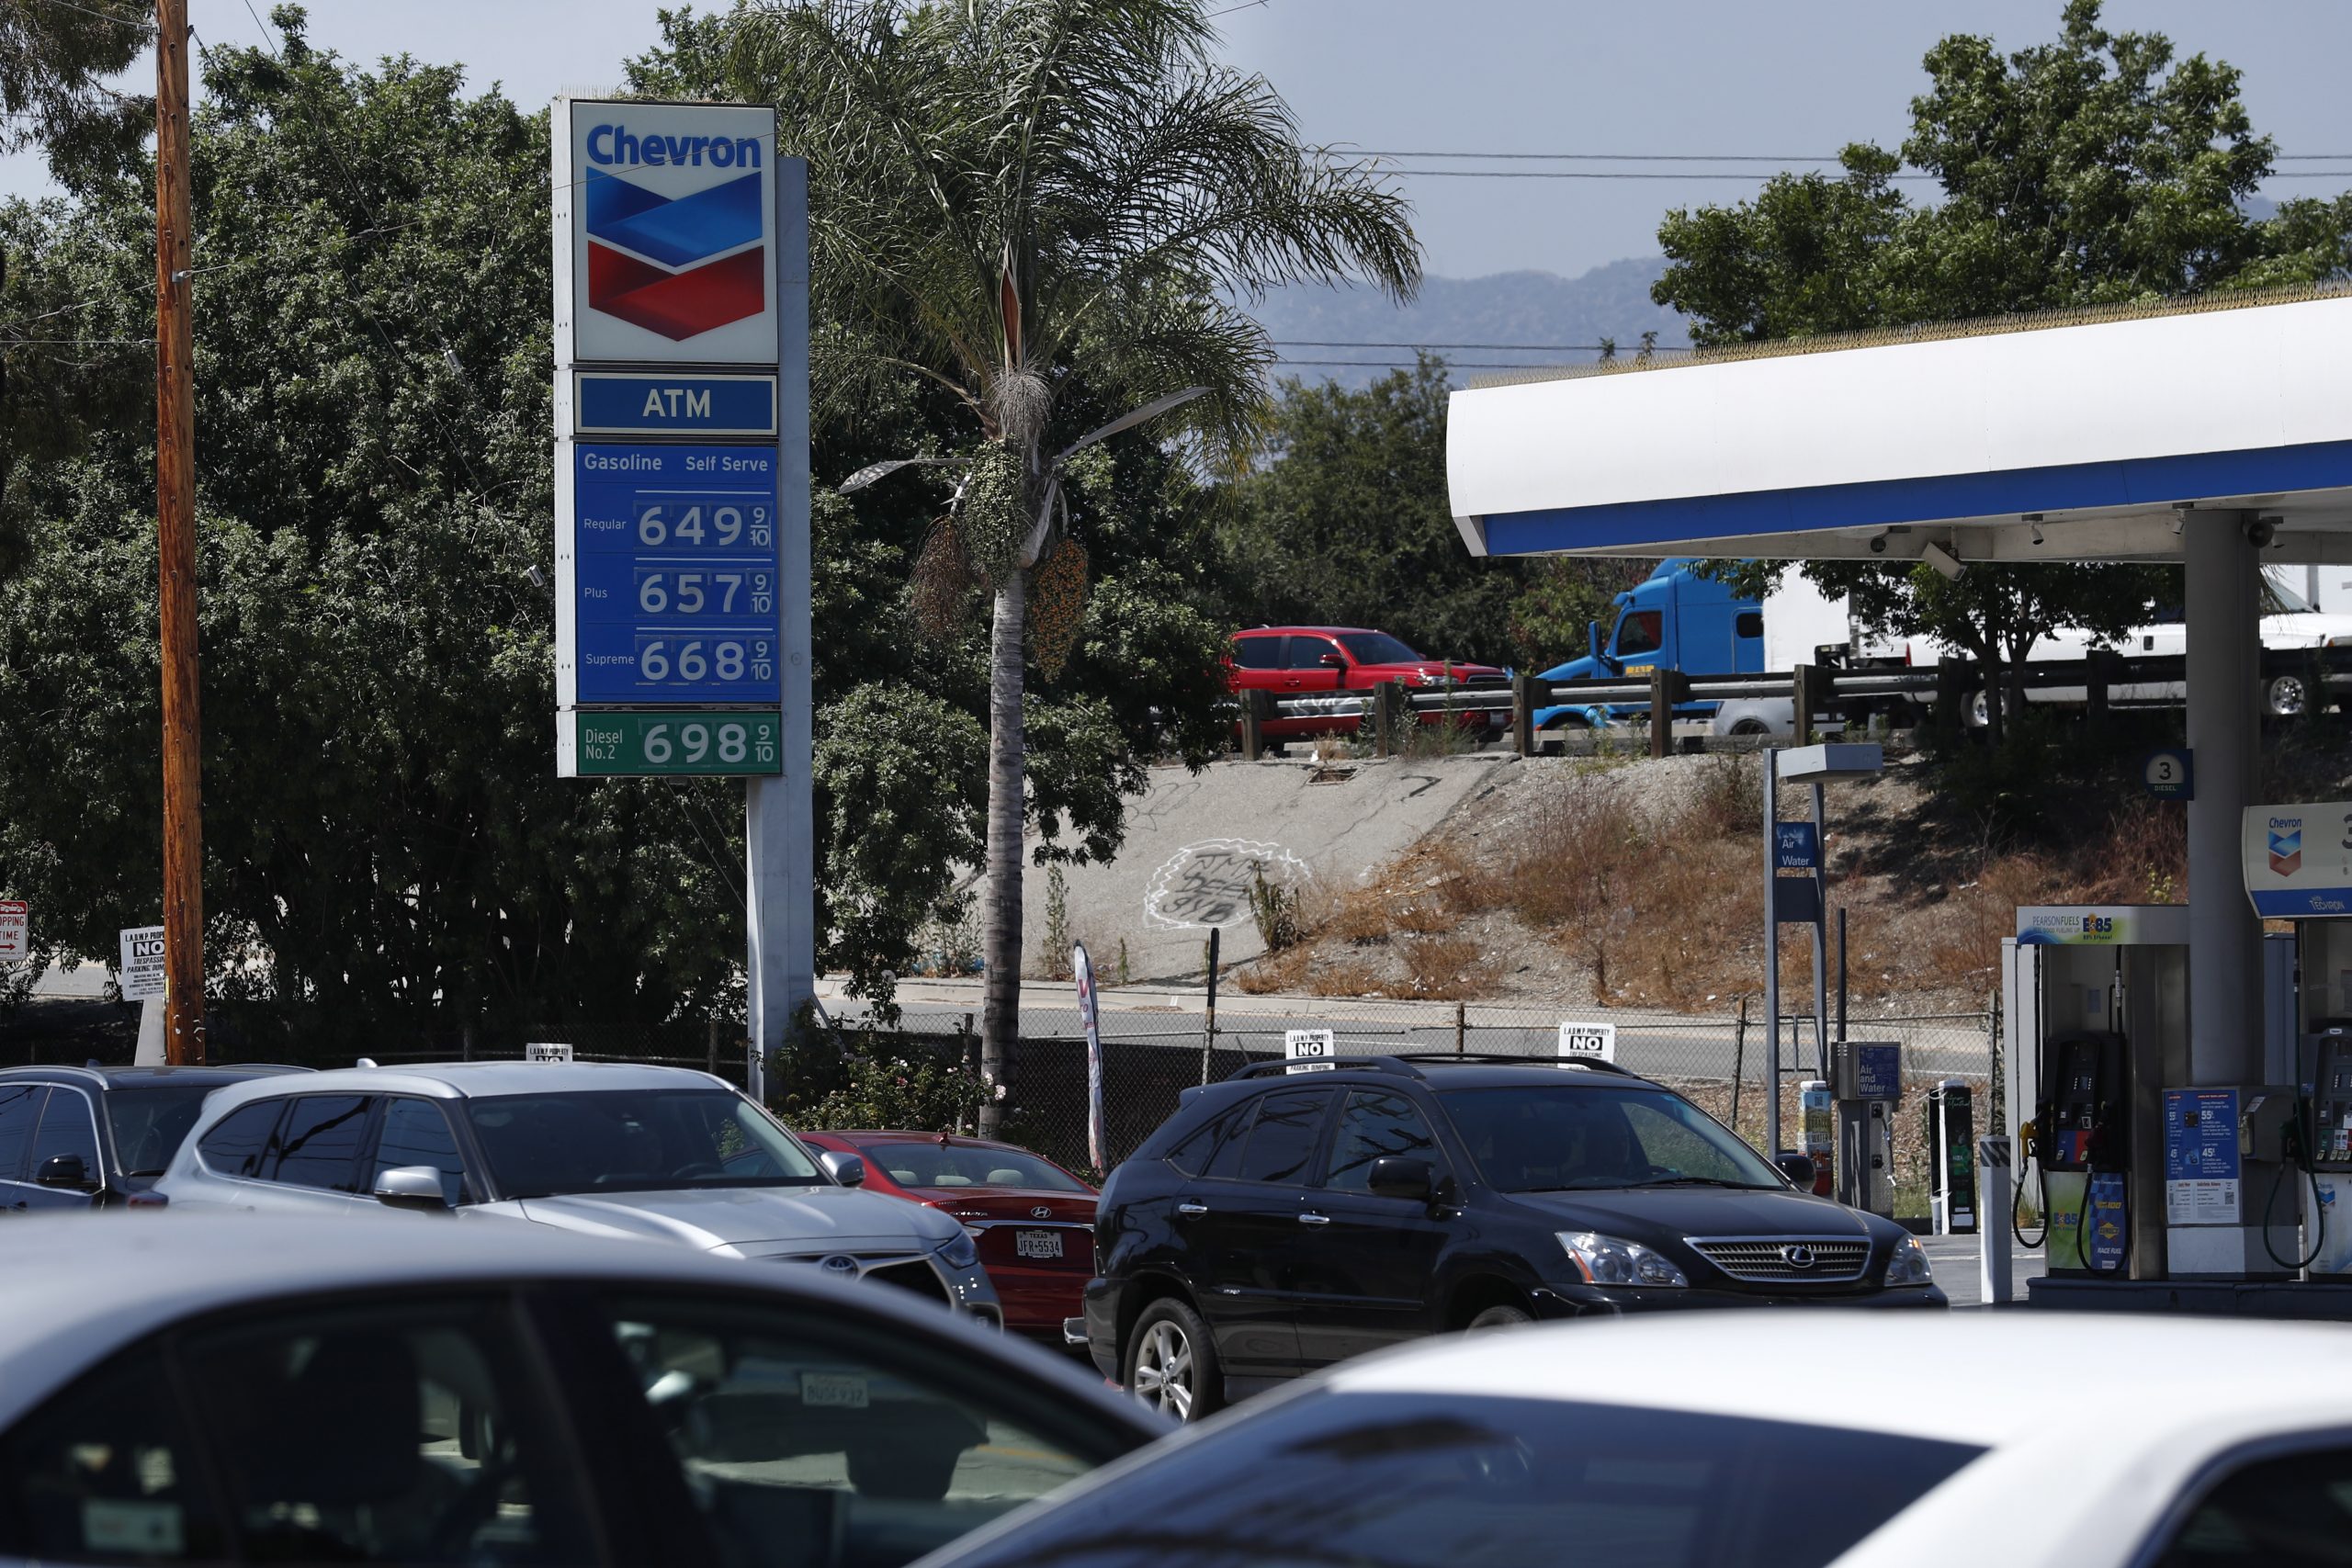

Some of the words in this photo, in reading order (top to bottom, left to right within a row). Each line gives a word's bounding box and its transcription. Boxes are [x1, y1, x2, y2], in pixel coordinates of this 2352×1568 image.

[586, 124, 762, 168] Chevron
[642, 389, 711, 418] ATM
[583, 453, 663, 471] Gasoline
[685, 456, 717, 471] Self
[721, 457, 768, 472] Serve
[583, 518, 628, 532] Regular
[639, 506, 742, 546] 649
[584, 587, 608, 599] Plus
[639, 573, 742, 614] 657
[585, 653, 635, 667] Supreme
[640, 641, 745, 681] 668
[585, 728, 623, 744] Diesel
[643, 723, 747, 763] 698
[2159, 761, 2171, 781] 3
[2268, 817, 2301, 829] Chevron
[1781, 838, 1794, 849] Air
[1781, 855, 1810, 866] Water
[136, 941, 165, 956] NO
[1297, 1043, 1322, 1055] NO
[1572, 1036, 1600, 1051] NO
[1860, 1064, 1872, 1074] Air
[1860, 1074, 1876, 1083] and
[1860, 1083, 1886, 1092] Water
